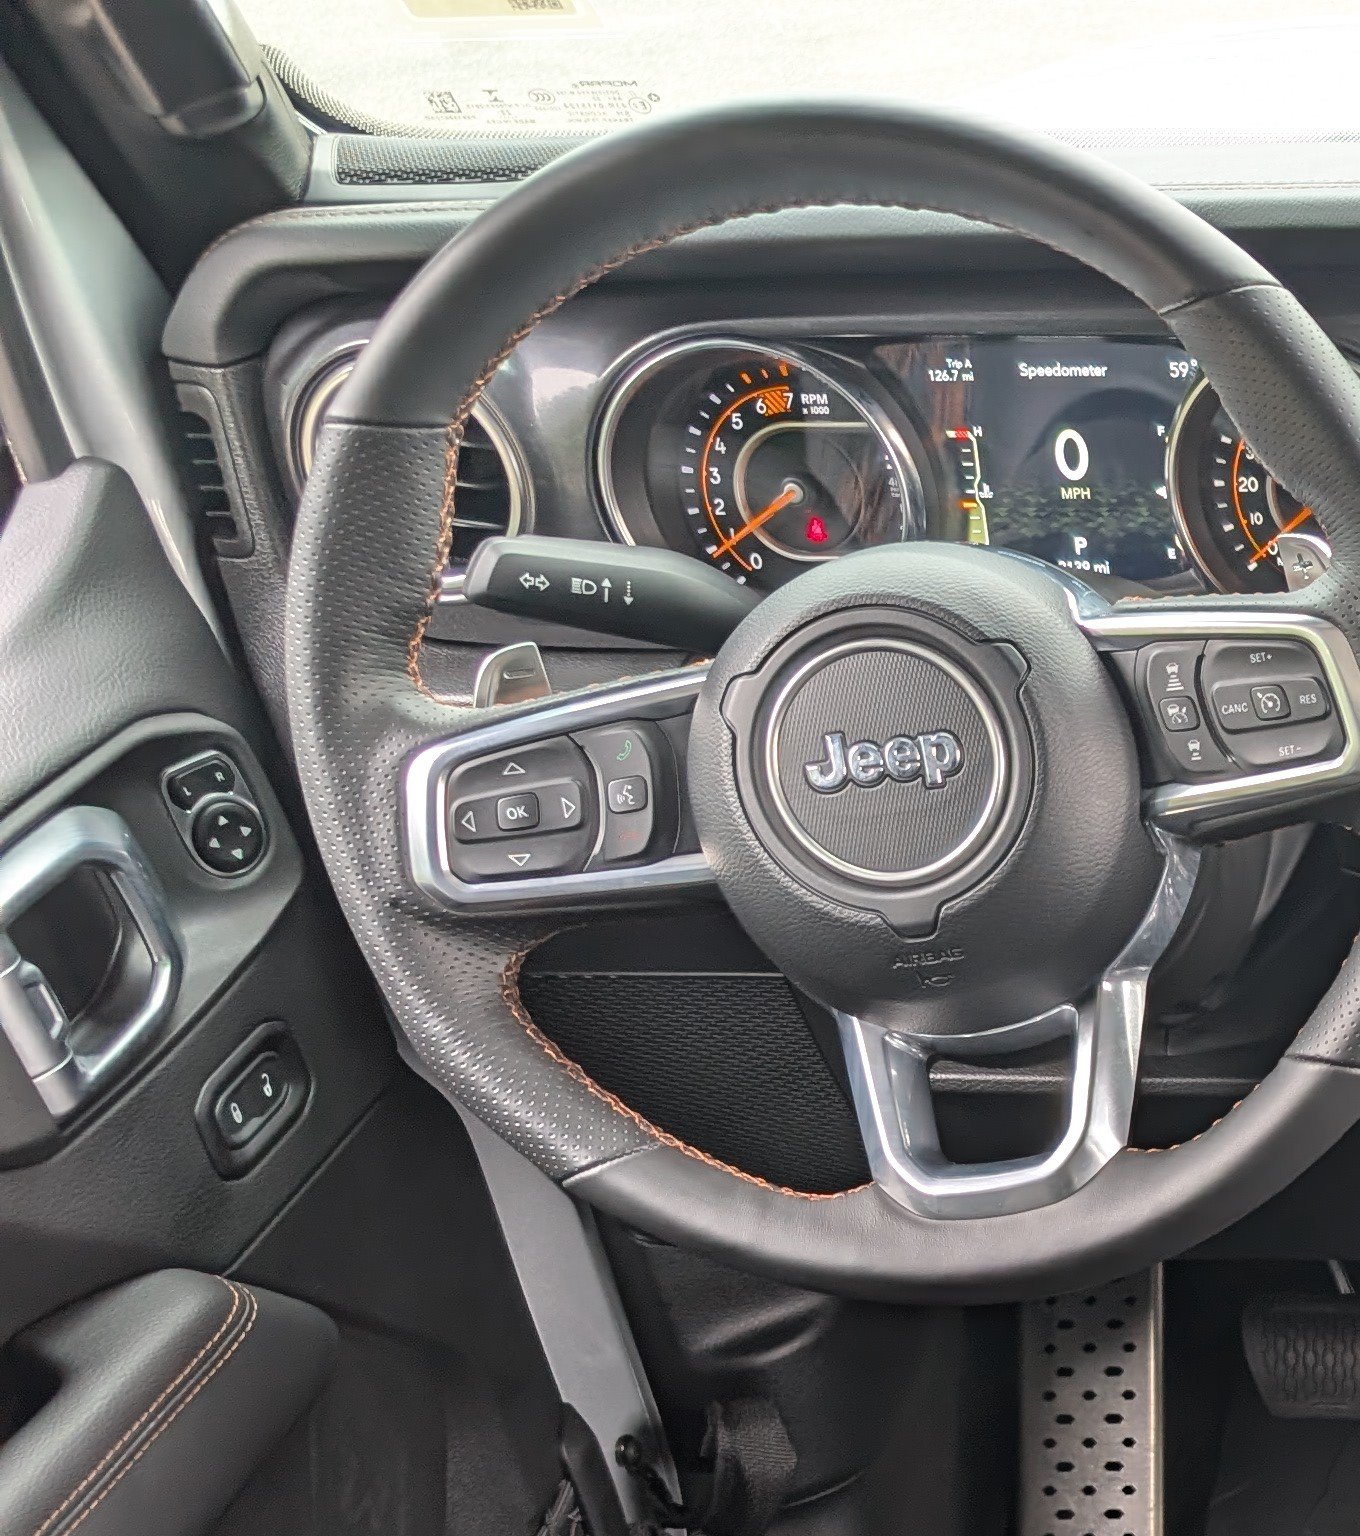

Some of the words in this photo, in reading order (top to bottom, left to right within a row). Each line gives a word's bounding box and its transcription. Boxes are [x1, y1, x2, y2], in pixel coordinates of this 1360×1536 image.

[946, 358, 963, 370] Trip
[964, 360, 973, 369] A
[1018, 363, 1108, 379] Speedometer
[928, 370, 959, 382] 126.7
[962, 371, 974, 381] mi
[755, 397, 767, 415] 6
[782, 392, 794, 410] 7
[800, 394, 829, 406] RPM
[810, 406, 830, 415] 1000
[731, 413, 743, 431] 5
[973, 426, 982, 437] H
[1157, 425, 1166, 436] F
[714, 437, 727, 454] 4
[1054, 428, 1089, 481] 0
[709, 467, 721, 484] 3
[1238, 476, 1259, 492] 20
[1060, 487, 1091, 500] MPH
[714, 498, 726, 516] 2
[1249, 511, 1264, 525] 10
[1073, 536, 1088, 556] P
[1166, 548, 1177, 559] E
[750, 553, 763, 570] 0
[1093, 560, 1111, 575] mi
[1221, 702, 1249, 715] CANC
[1299, 693, 1317, 704] RES
[804, 730, 966, 795] Jeep
[215, 771, 225, 782] R
[182, 787, 191, 796] L
[505, 805, 530, 820] OK
[892, 948, 966, 969] AIRBAG
